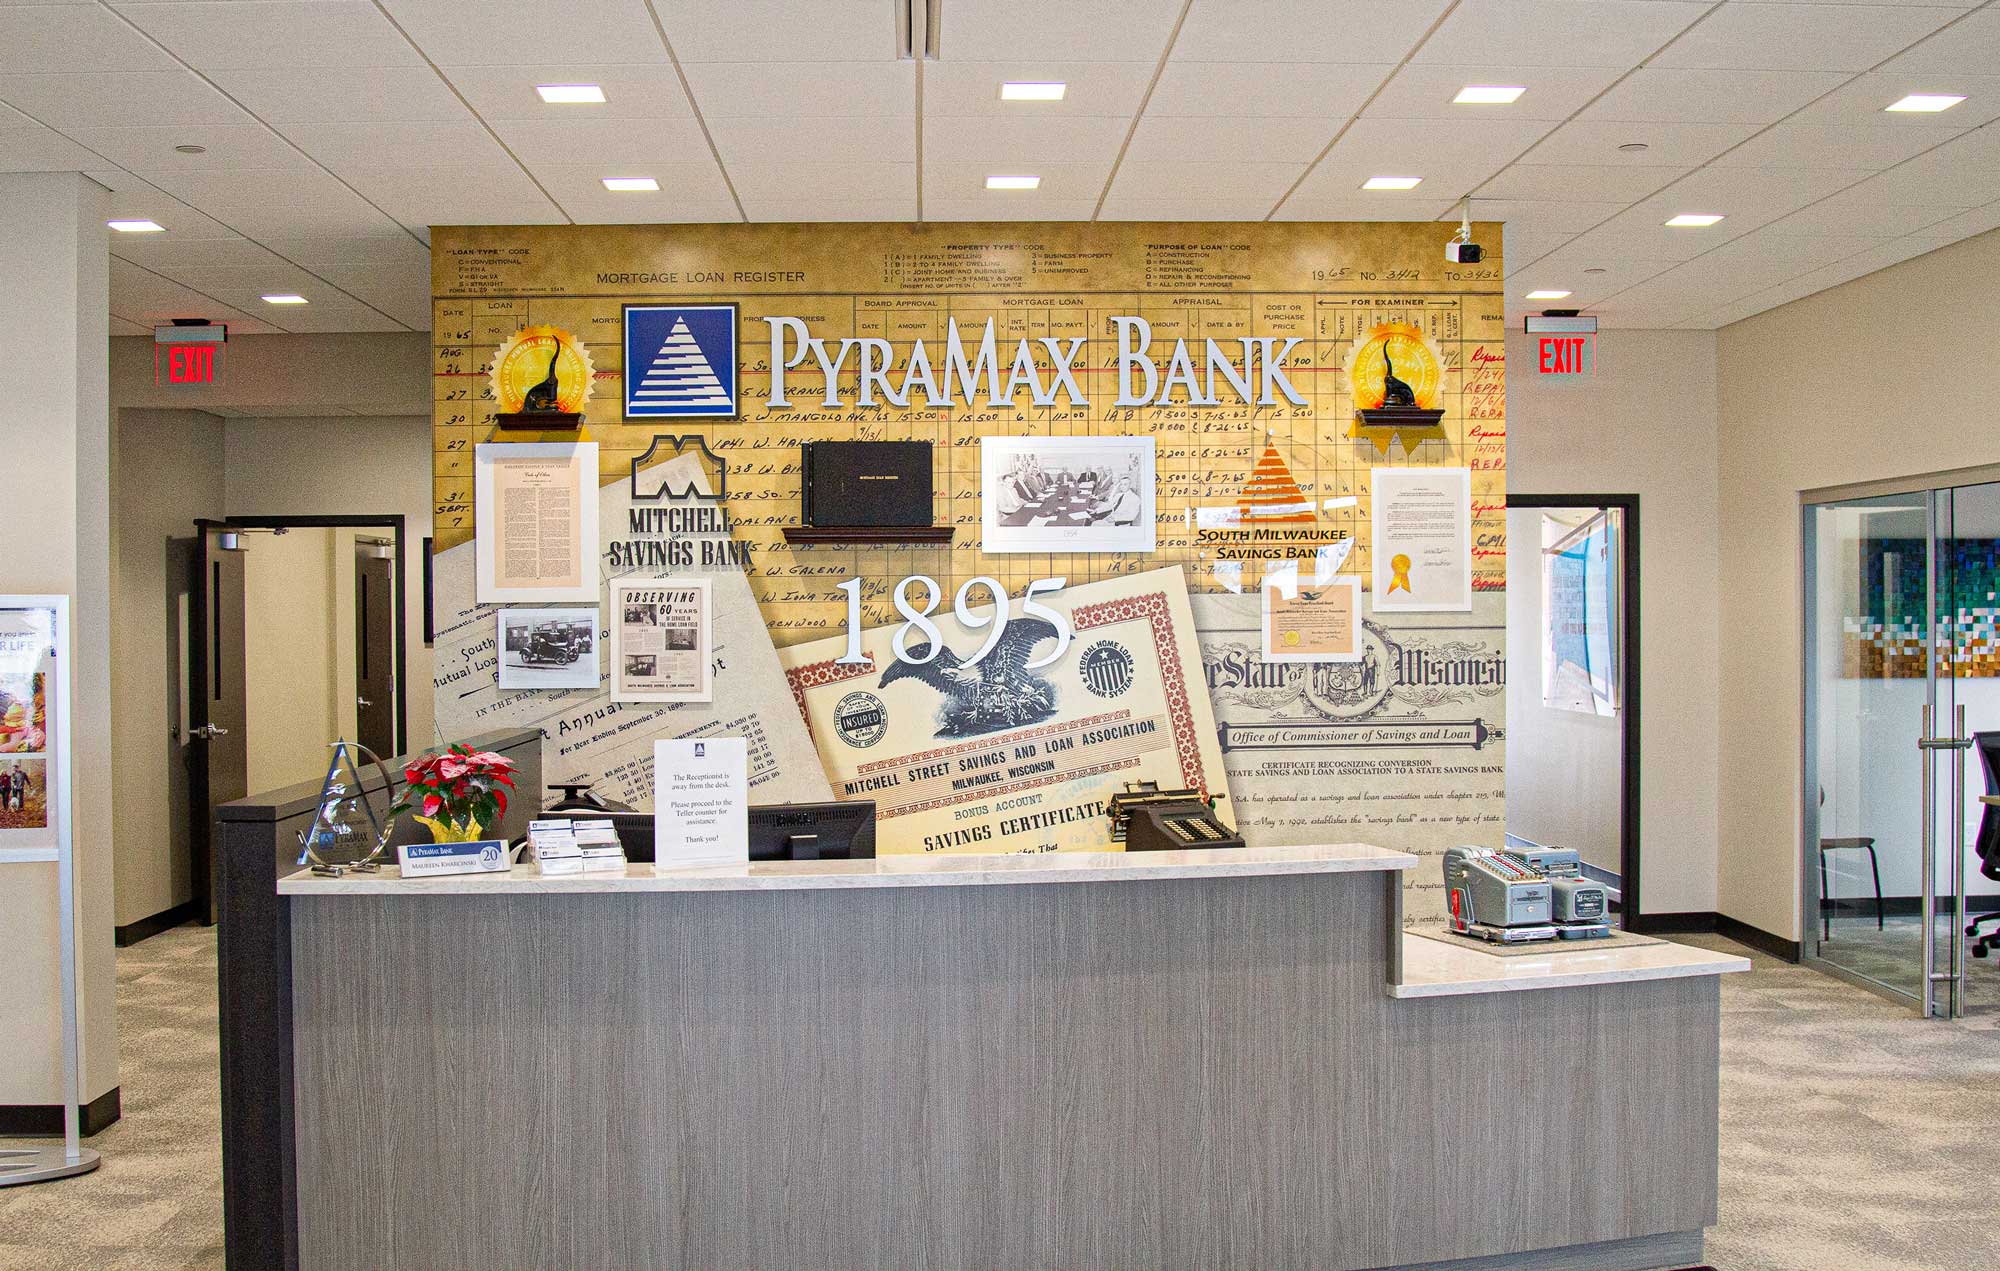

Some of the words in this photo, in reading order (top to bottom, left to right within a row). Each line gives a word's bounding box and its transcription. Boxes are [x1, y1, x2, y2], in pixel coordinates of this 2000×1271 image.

[596, 272, 678, 284] MORTGAGE
[686, 271, 725, 283] LOAN
[733, 271, 805, 282] REGISTER
[1312, 270, 1324, 281] 19
[1172, 298, 1222, 306] APPRAISAL
[1539, 337, 1585, 374] EXIT
[169, 346, 216, 384] EXIT
[446, 390, 467, 401] 27
[446, 414, 465, 425] 30
[447, 440, 467, 450] 27
[628, 507, 734, 534] MITCHELL
[609, 540, 694, 567] SAVINGS
[701, 540, 753, 567] BANK
[789, 566, 848, 576] GALENA
[626, 591, 695, 603] OBSERVING
[659, 604, 672, 615] 60
[835, 574, 1075, 670] 1895
[461, 638, 496, 662] South
[1079, 645, 1097, 675] FEDERAL
[1096, 639, 1120, 649] HOME
[1119, 646, 1134, 666] LOAN
[1086, 683, 1107, 698] BANK
[1108, 676, 1134, 698] SYSTEM
[475, 707, 487, 718] IN
[490, 697, 513, 712] THE
[558, 702, 623, 737] Annual
[842, 712, 879, 729] INSURED
[592, 729, 617, 743] Ending
[617, 714, 653, 733] September
[1232, 731, 1265, 745] Office
[1268, 731, 1280, 744] of
[1282, 730, 1359, 742] Commissioner
[1362, 730, 1373, 743] of
[1375, 729, 1416, 742] Savings
[1419, 729, 1440, 739] and
[1443, 728, 1471, 739] Loan
[844, 773, 901, 796] MITCHELL
[908, 762, 950, 782] STREET
[959, 751, 1006, 772] SAVINGS
[1015, 744, 1036, 760] AND
[1045, 737, 1074, 753] LOAN
[1082, 719, 1155, 746] ASSOCIATION
[1318, 760, 1376, 769] RECOGNIZING
[1378, 759, 1432, 768] CONVERSION
[686, 773, 723, 783] Receptionist
[951, 771, 1004, 791] MILWAUKEE,
[1007, 760, 1055, 778] WISCONSIN
[1227, 769, 1253, 777] STATE
[1255, 768, 1290, 777] SAVINGS
[1292, 768, 1311, 776] AND
[1312, 768, 1335, 776] LOAN
[1337, 767, 1393, 776] ASSOCIATION
[1394, 767, 1407, 775] TO
[1408, 767, 1414, 775] A
[1416, 766, 1442, 774] STATE
[1444, 766, 1479, 774] SAVINGS
[1481, 765, 1504, 773] BANK
[670, 801, 690, 809] Please
[690, 799, 715, 809] proceed
[1267, 792, 1298, 805] operated
[1363, 790, 1380, 801] loan
[1382, 790, 1421, 800] association
[1424, 790, 1444, 800] under
[1446, 789, 1473, 802] chapter
[676, 809, 694, 817] Teller
[694, 808, 717, 816] counter
[954, 805, 989, 821] BONUS
[995, 793, 1043, 812] ACCOUNT
[923, 824, 992, 852] SAVINGS
[1000, 800, 1106, 836] CERTIFICATE
[1310, 814, 1348, 825] establishes
[1350, 814, 1362, 825] the
[1455, 815, 1470, 825] type
[685, 836, 704, 844] Thank
[705, 834, 720, 845] you!
[483, 849, 498, 862] 20
